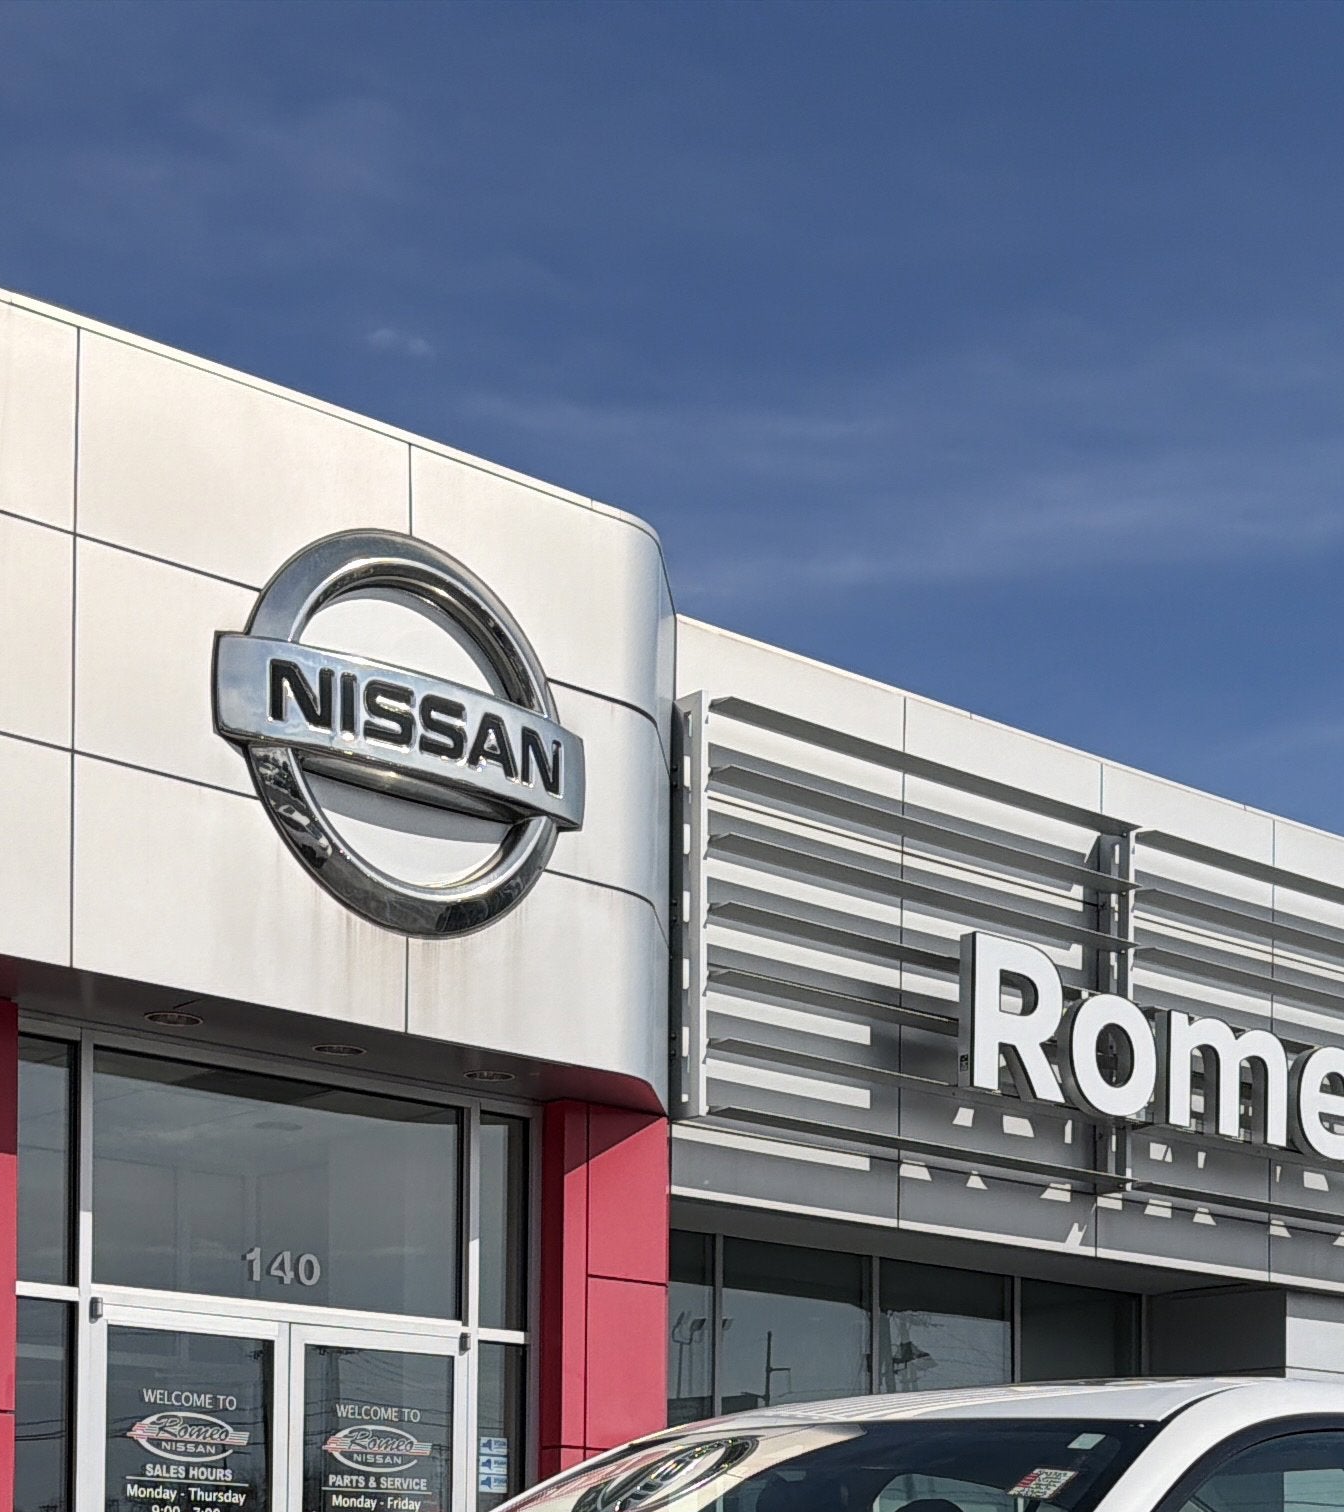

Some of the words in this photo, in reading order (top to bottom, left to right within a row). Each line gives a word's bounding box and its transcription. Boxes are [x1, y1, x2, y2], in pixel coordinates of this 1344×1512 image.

[268, 658, 563, 799] NISSAN
[244, 1246, 321, 1286] 140
[143, 1387, 213, 1409] WELCOME
[217, 1395, 237, 1411] TO
[336, 1403, 399, 1421] WELCOME
[402, 1408, 421, 1422] TO
[150, 1414, 230, 1441] Romeo
[161, 1441, 216, 1454] NISSAN
[342, 1427, 415, 1452] Romeo
[353, 1453, 402, 1464] NISSAN
[145, 1463, 186, 1479] SALES
[189, 1466, 233, 1481] HOURS
[328, 1474, 365, 1488] PARTS
[368, 1476, 377, 1488] &
[380, 1477, 427, 1490] SERVICE
[126, 1483, 177, 1501] Monday
[188, 1487, 246, 1506] Thursday
[332, 1494, 377, 1511] Monday
[387, 1497, 421, 1512] Friday
